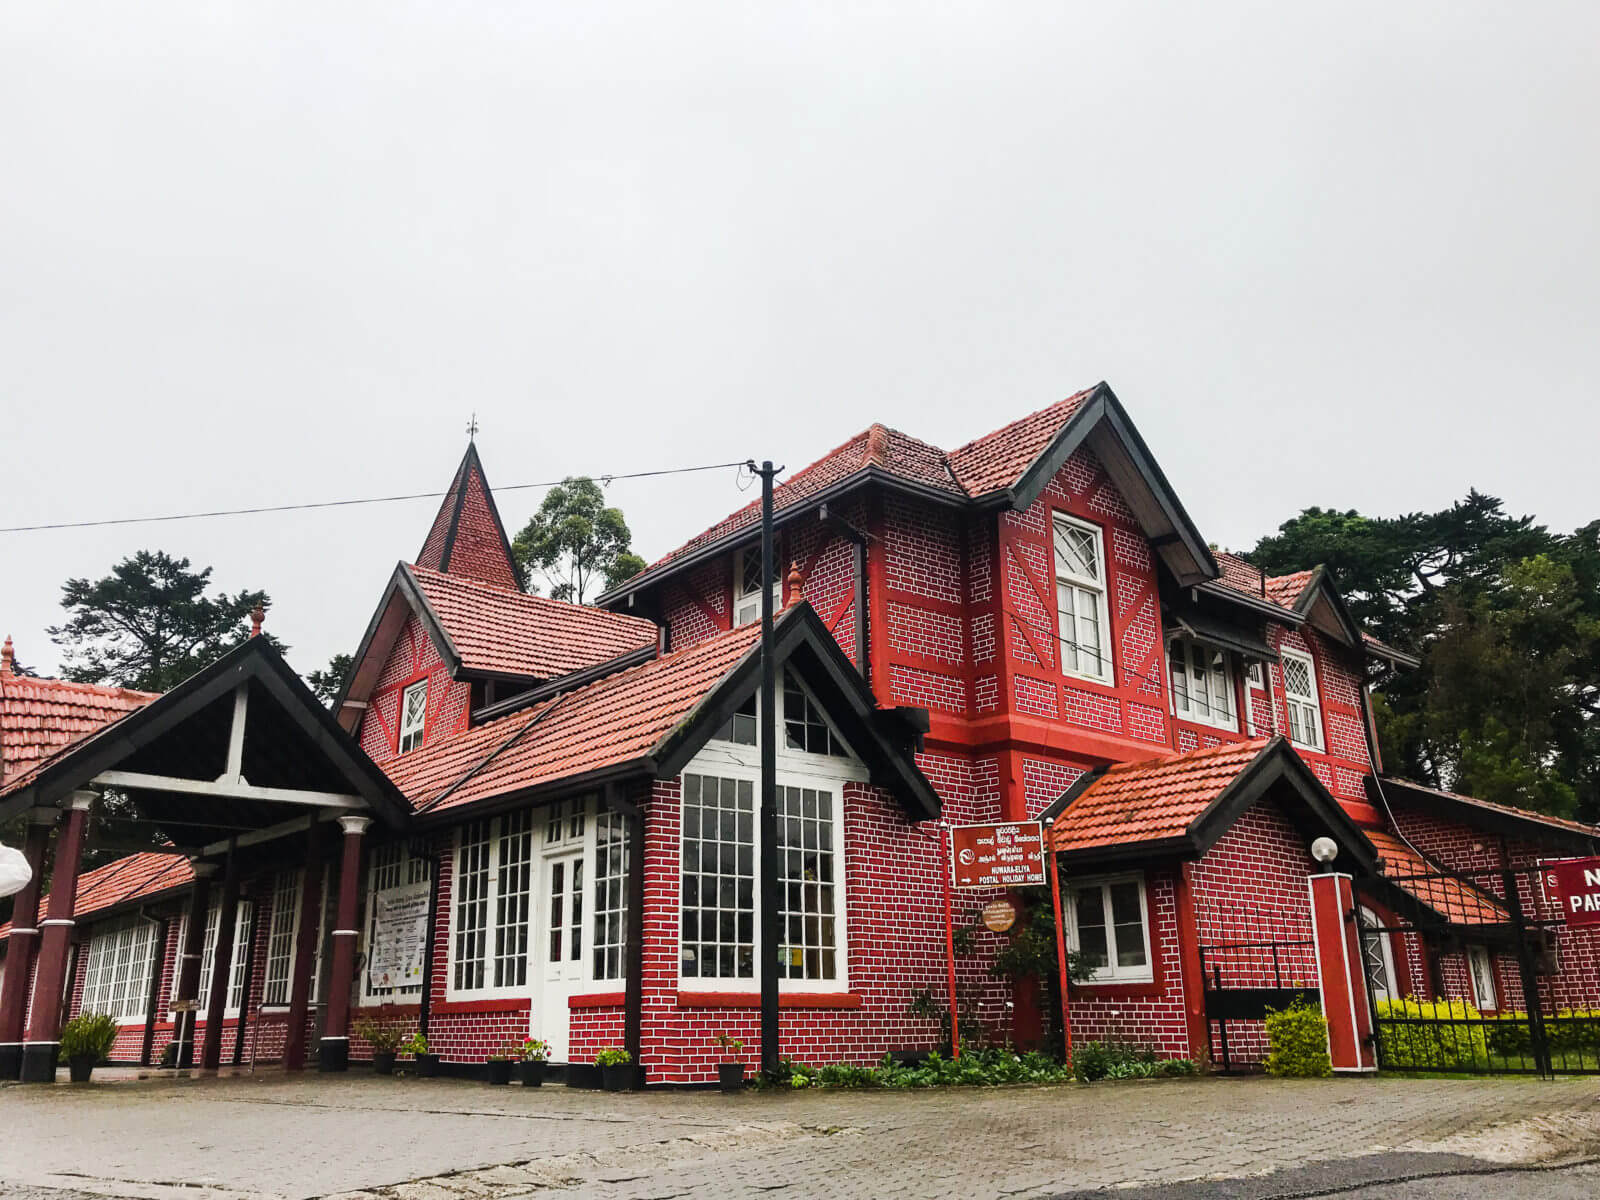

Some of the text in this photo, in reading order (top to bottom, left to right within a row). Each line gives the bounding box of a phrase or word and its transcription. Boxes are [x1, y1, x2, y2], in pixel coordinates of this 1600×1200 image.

[991, 865, 1031, 874] NUWARA-ELIYA
[979, 873, 1043, 885] POSTAL HOLIDAY HOME
